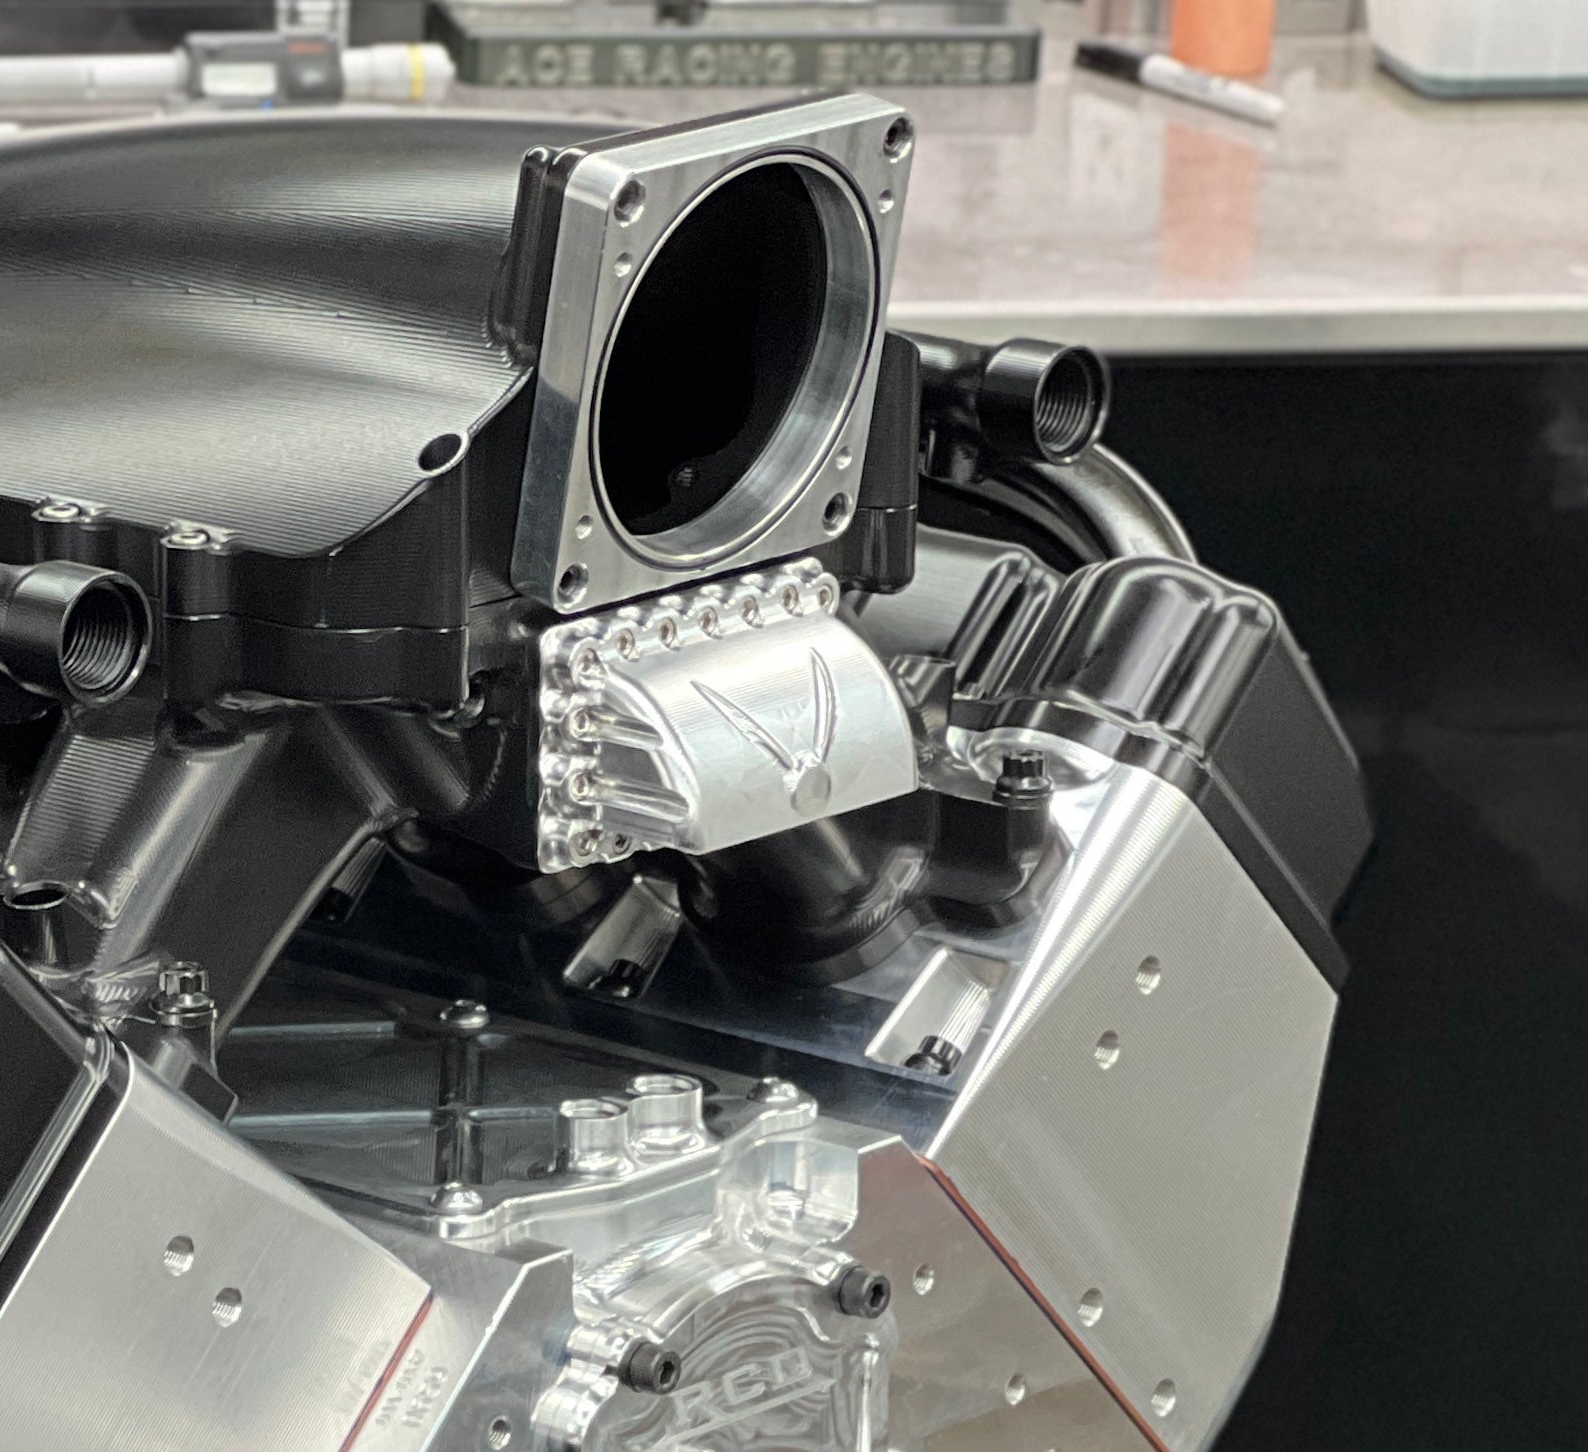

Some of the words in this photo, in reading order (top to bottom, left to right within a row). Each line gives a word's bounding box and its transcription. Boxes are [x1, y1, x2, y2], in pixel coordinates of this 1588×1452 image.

[495, 42, 596, 86] ACE
[614, 42, 798, 87] RACING
[818, 41, 1013, 87] ENGINES
[668, 1345, 813, 1426] RCD
